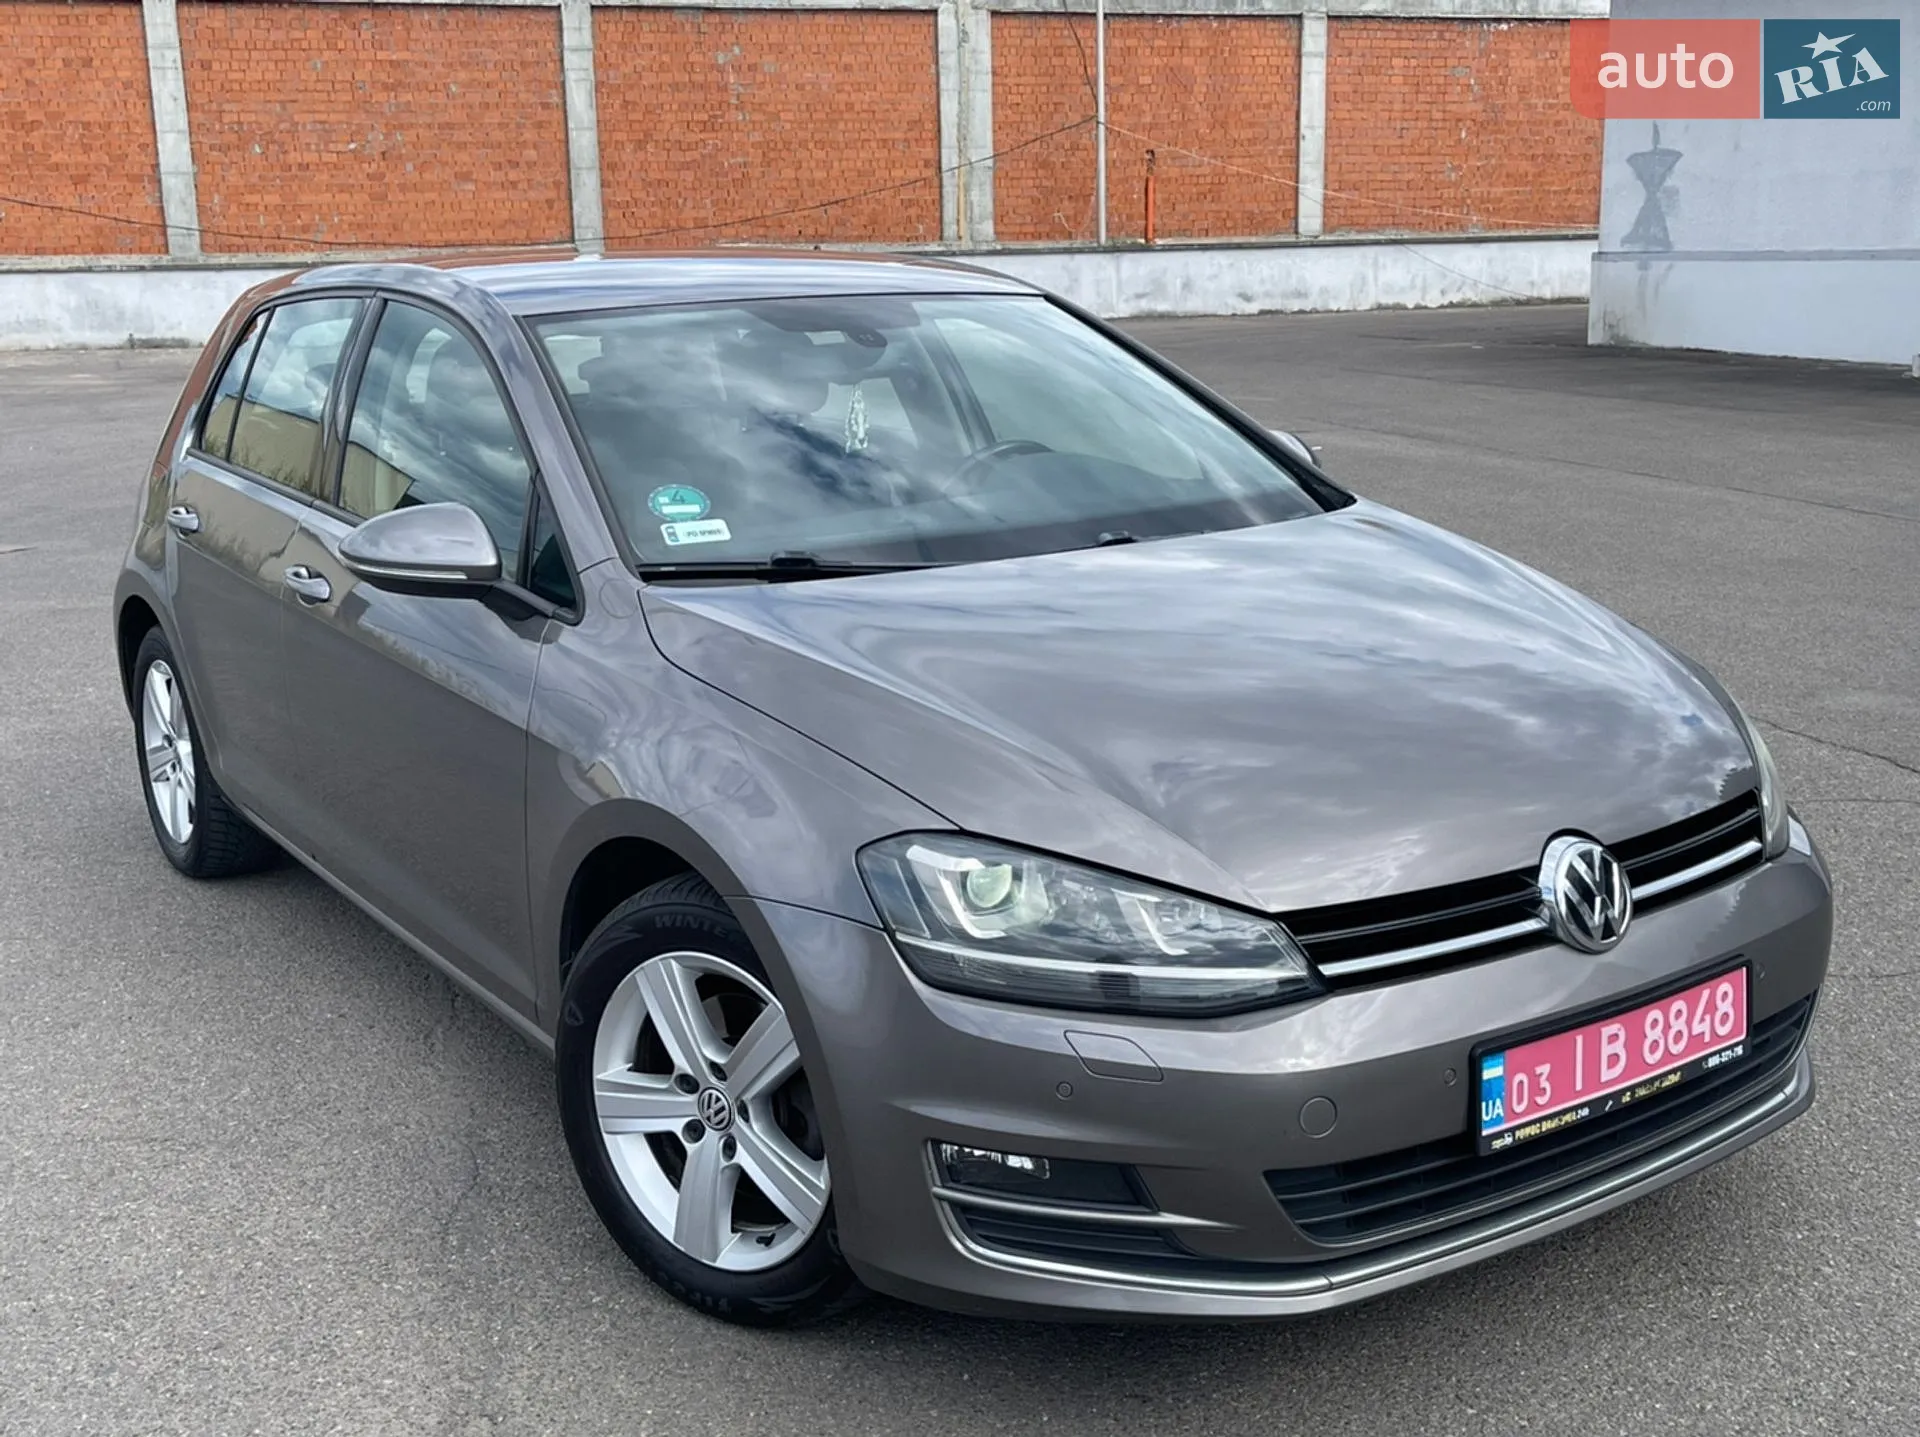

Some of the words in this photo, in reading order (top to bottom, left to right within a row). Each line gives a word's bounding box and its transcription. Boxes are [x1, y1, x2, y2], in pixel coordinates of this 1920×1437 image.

[1512, 1063, 1551, 1114] 03
[1574, 1022, 1627, 1091] IB
[1642, 981, 1735, 1065] 8848
[1482, 1098, 1504, 1121] UA
